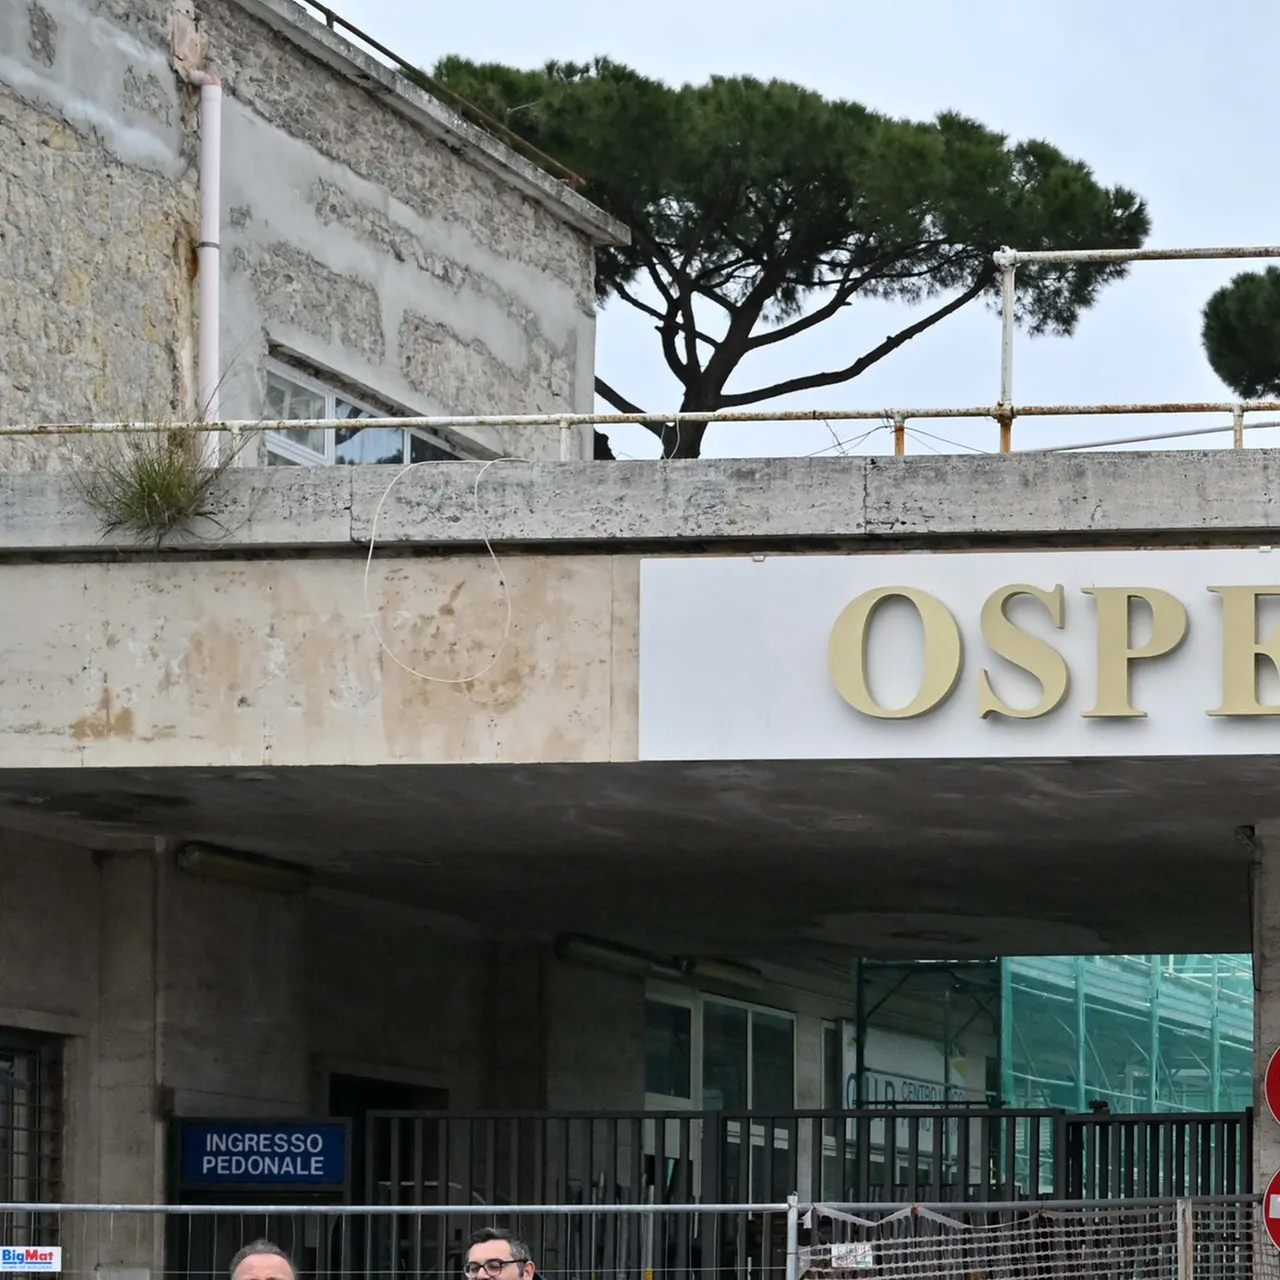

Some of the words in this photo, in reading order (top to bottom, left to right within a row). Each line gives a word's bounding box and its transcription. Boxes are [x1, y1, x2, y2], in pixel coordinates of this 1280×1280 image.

[205, 1133, 323, 1153] INGRESSO
[203, 1155, 324, 1175] PEDONALE
[2, 1248, 54, 1264] BigMat
